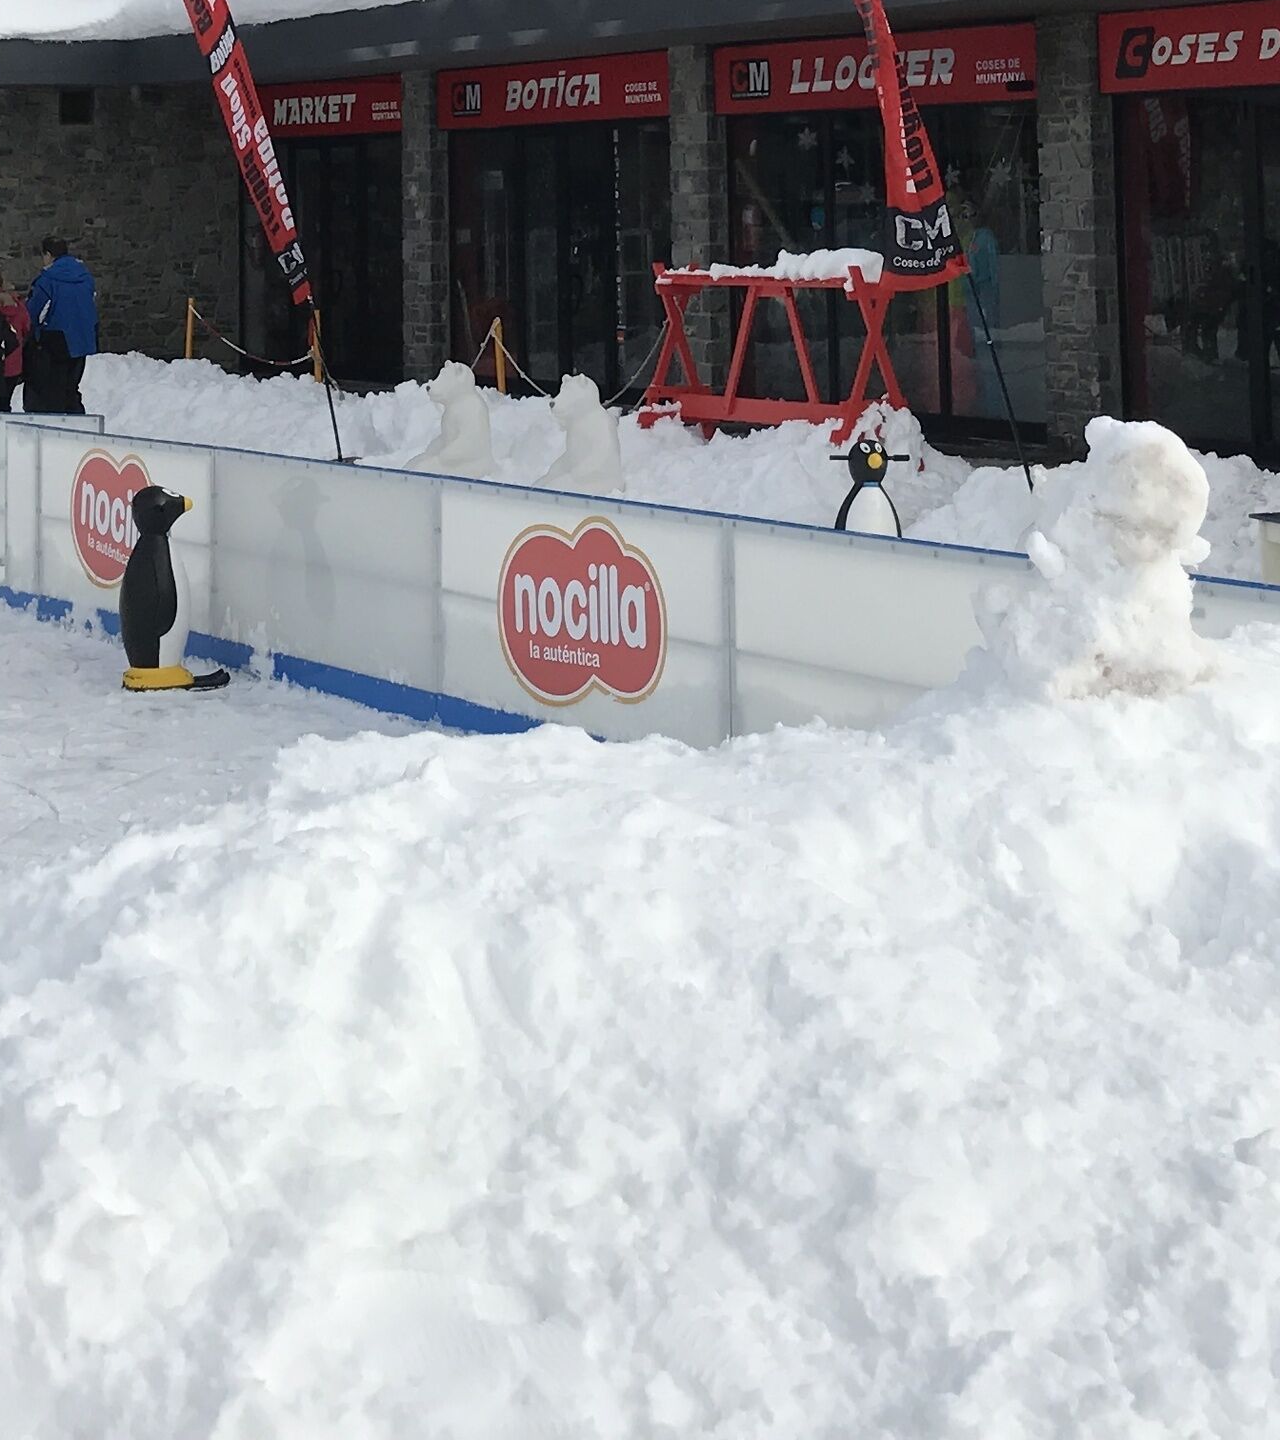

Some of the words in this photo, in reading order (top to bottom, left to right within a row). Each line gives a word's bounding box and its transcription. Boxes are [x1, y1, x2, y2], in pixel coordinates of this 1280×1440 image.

[1123, 29, 1244, 67] COSES
[975, 59, 1006, 71] COSES
[1008, 57, 1020, 69] DE
[975, 71, 1026, 85] MUNTANYA
[273, 93, 357, 126] MARKET
[514, 563, 647, 650] nocilla
[529, 640, 541, 659] la
[543, 644, 601, 668] auténtica
